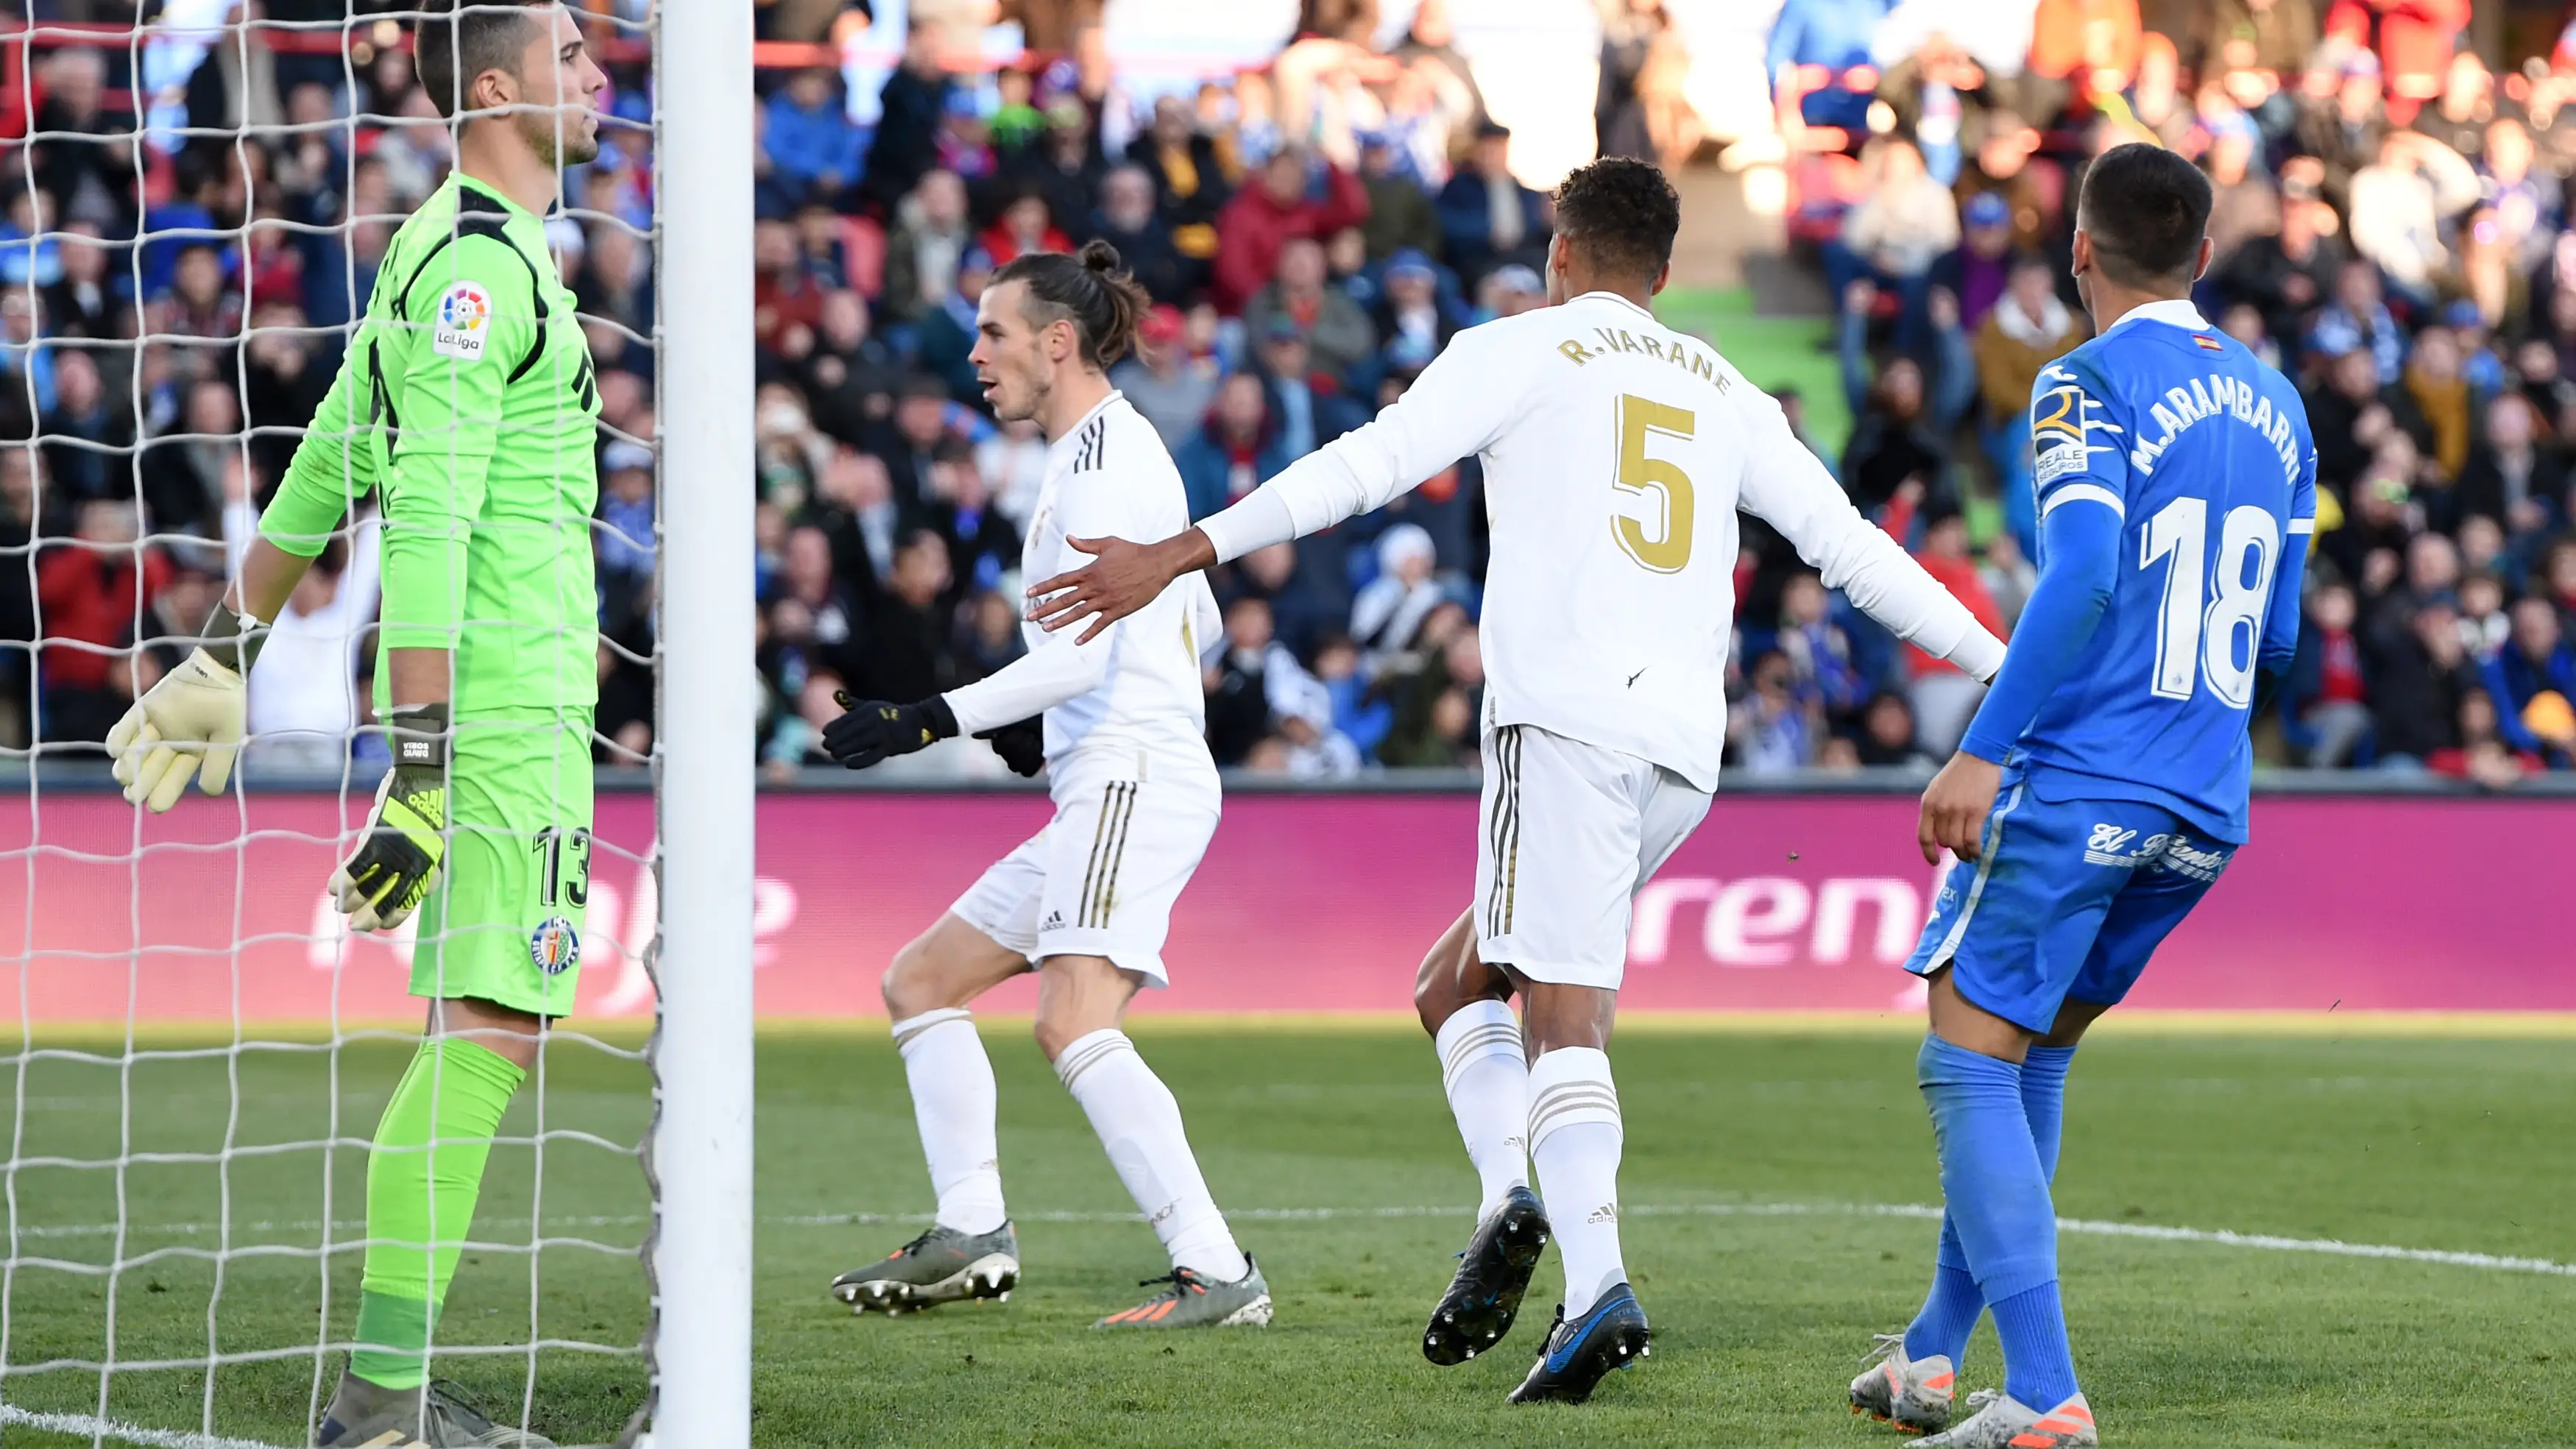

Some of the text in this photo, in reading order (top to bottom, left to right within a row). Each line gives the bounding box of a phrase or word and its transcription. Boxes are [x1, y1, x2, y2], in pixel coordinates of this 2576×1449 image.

[438, 332, 479, 350] LaLiga
[1557, 327, 1731, 396] R.VARANE
[2037, 450, 2084, 472] REALE
[2131, 374, 2301, 486] M.ARAMBARRI
[1610, 392, 1695, 575] 5
[2038, 461, 2085, 483] SEGUROS
[2139, 496, 2280, 709] 18
[531, 825, 590, 910] 13
